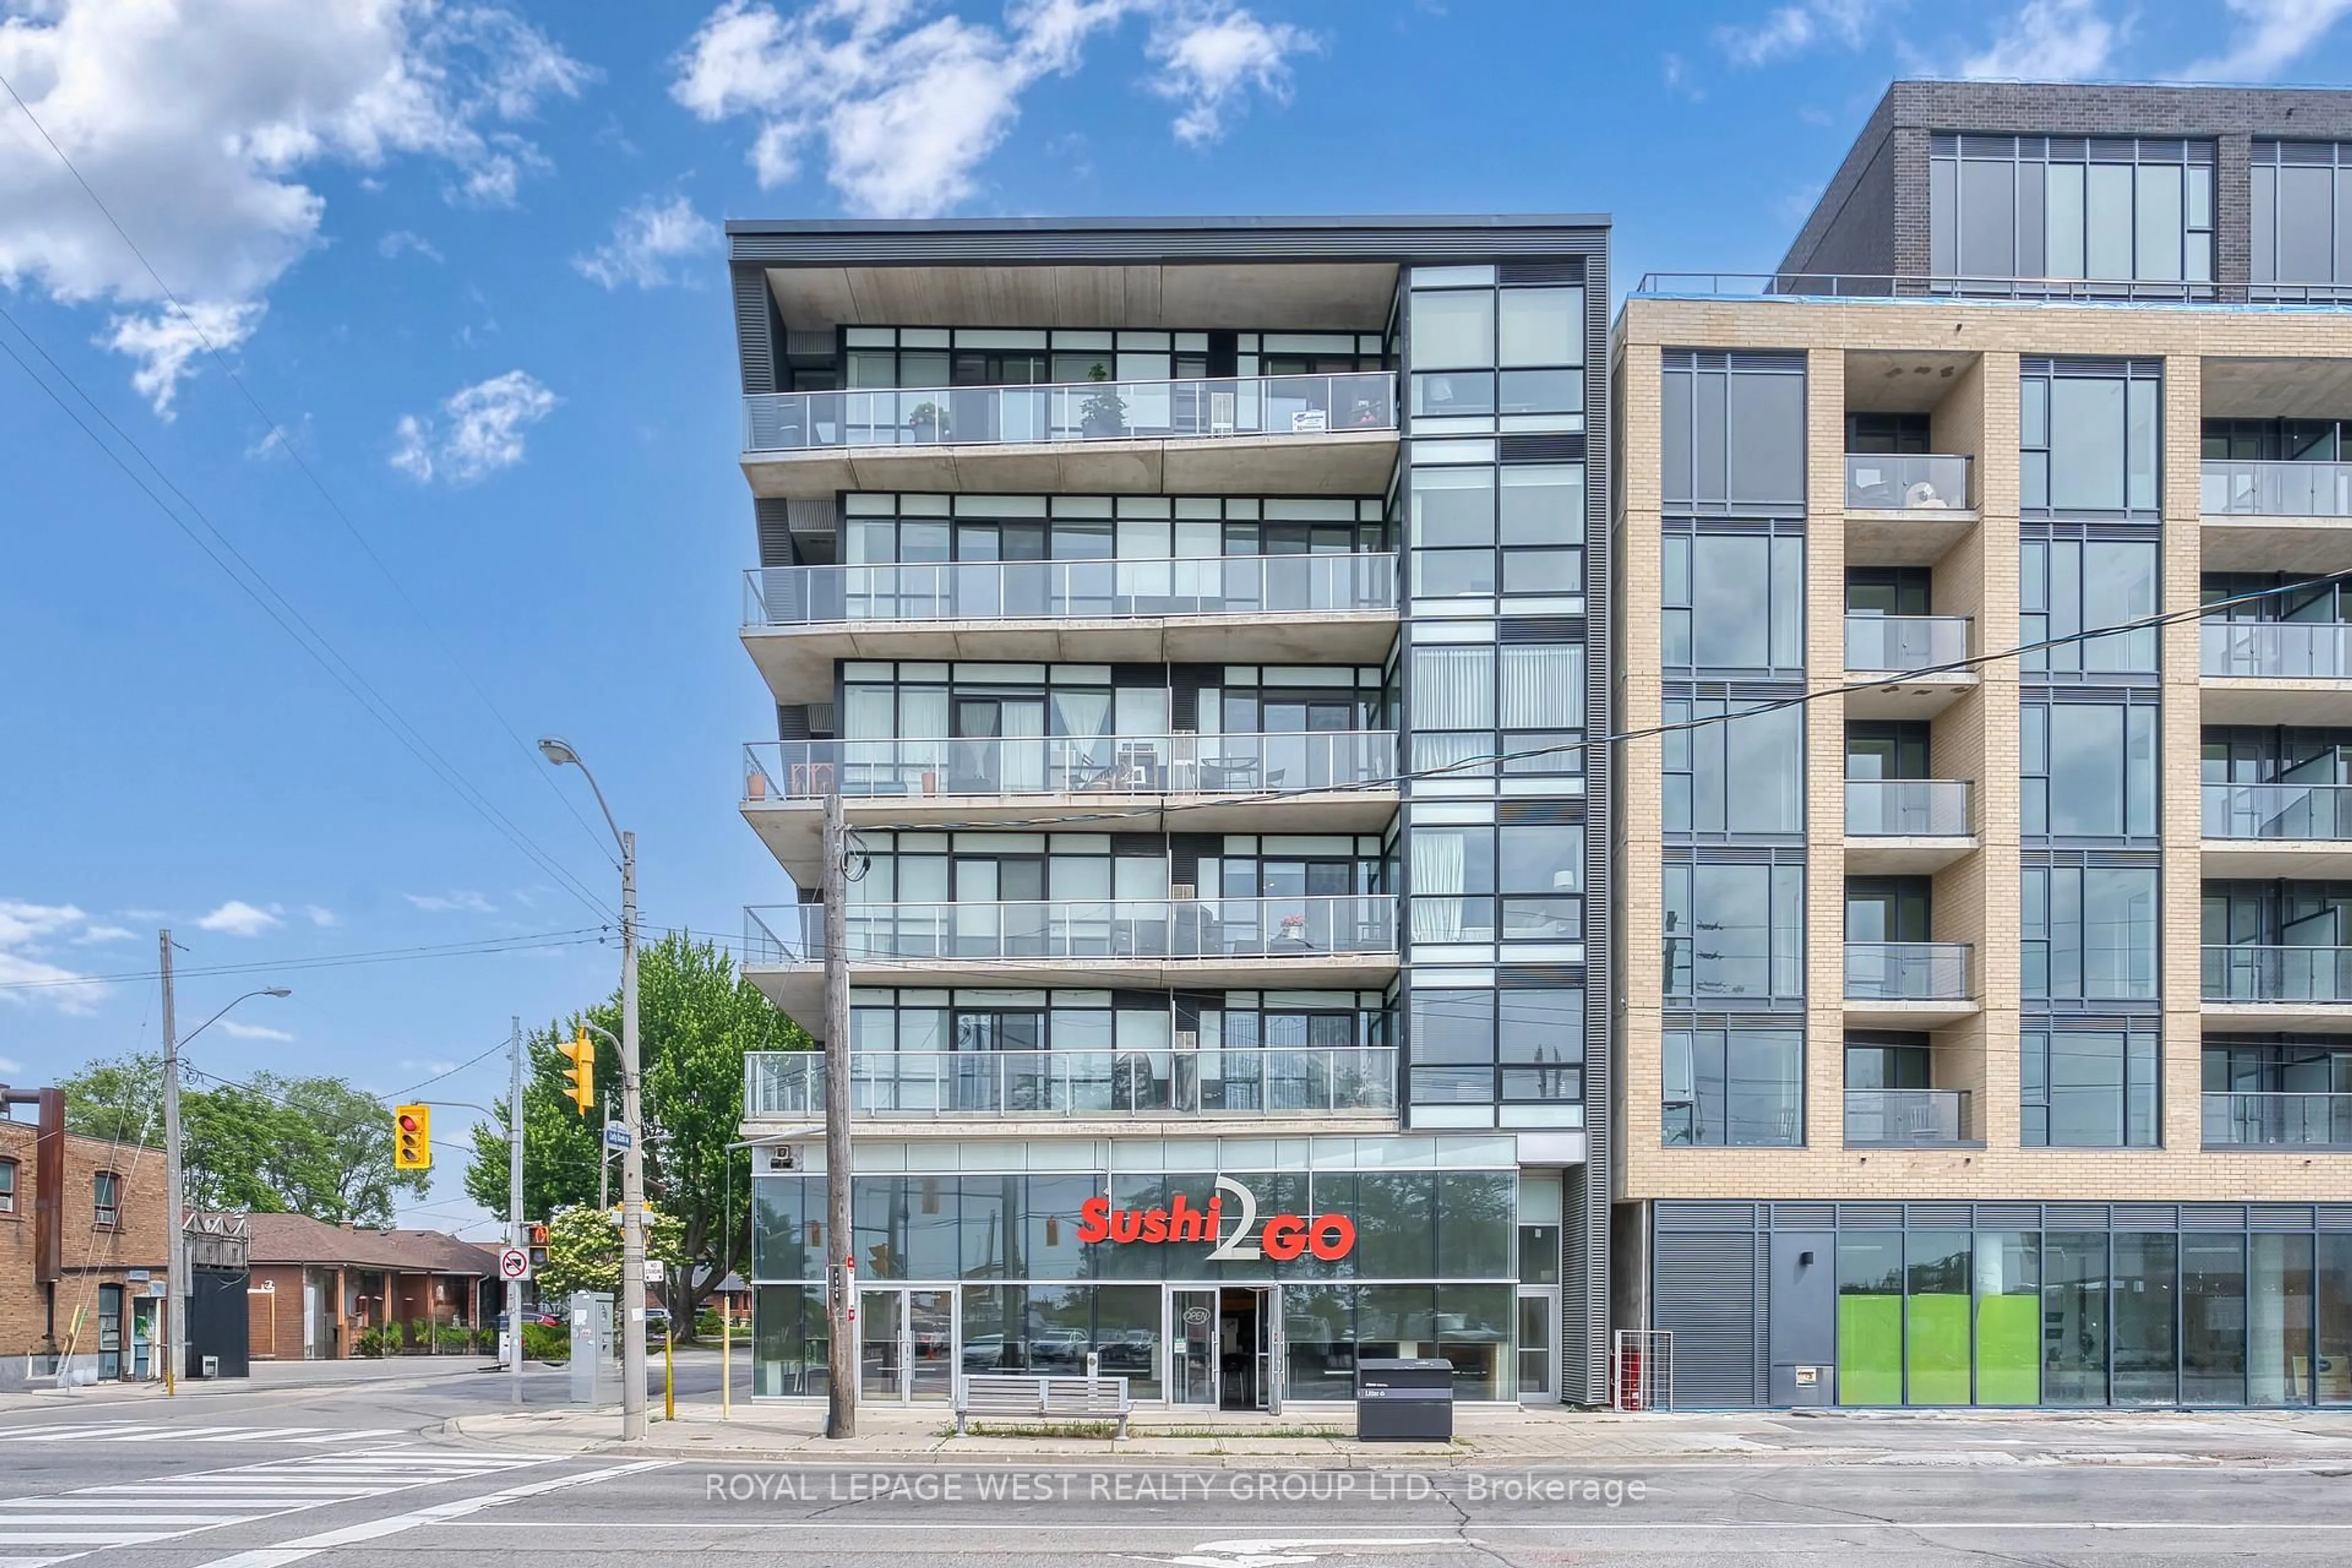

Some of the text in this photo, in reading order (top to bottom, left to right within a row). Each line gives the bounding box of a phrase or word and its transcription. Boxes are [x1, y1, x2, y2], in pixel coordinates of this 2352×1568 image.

[1077, 1175, 1355, 1261] Sushi 2 GO
[1185, 1311, 1208, 1321] OPEN
